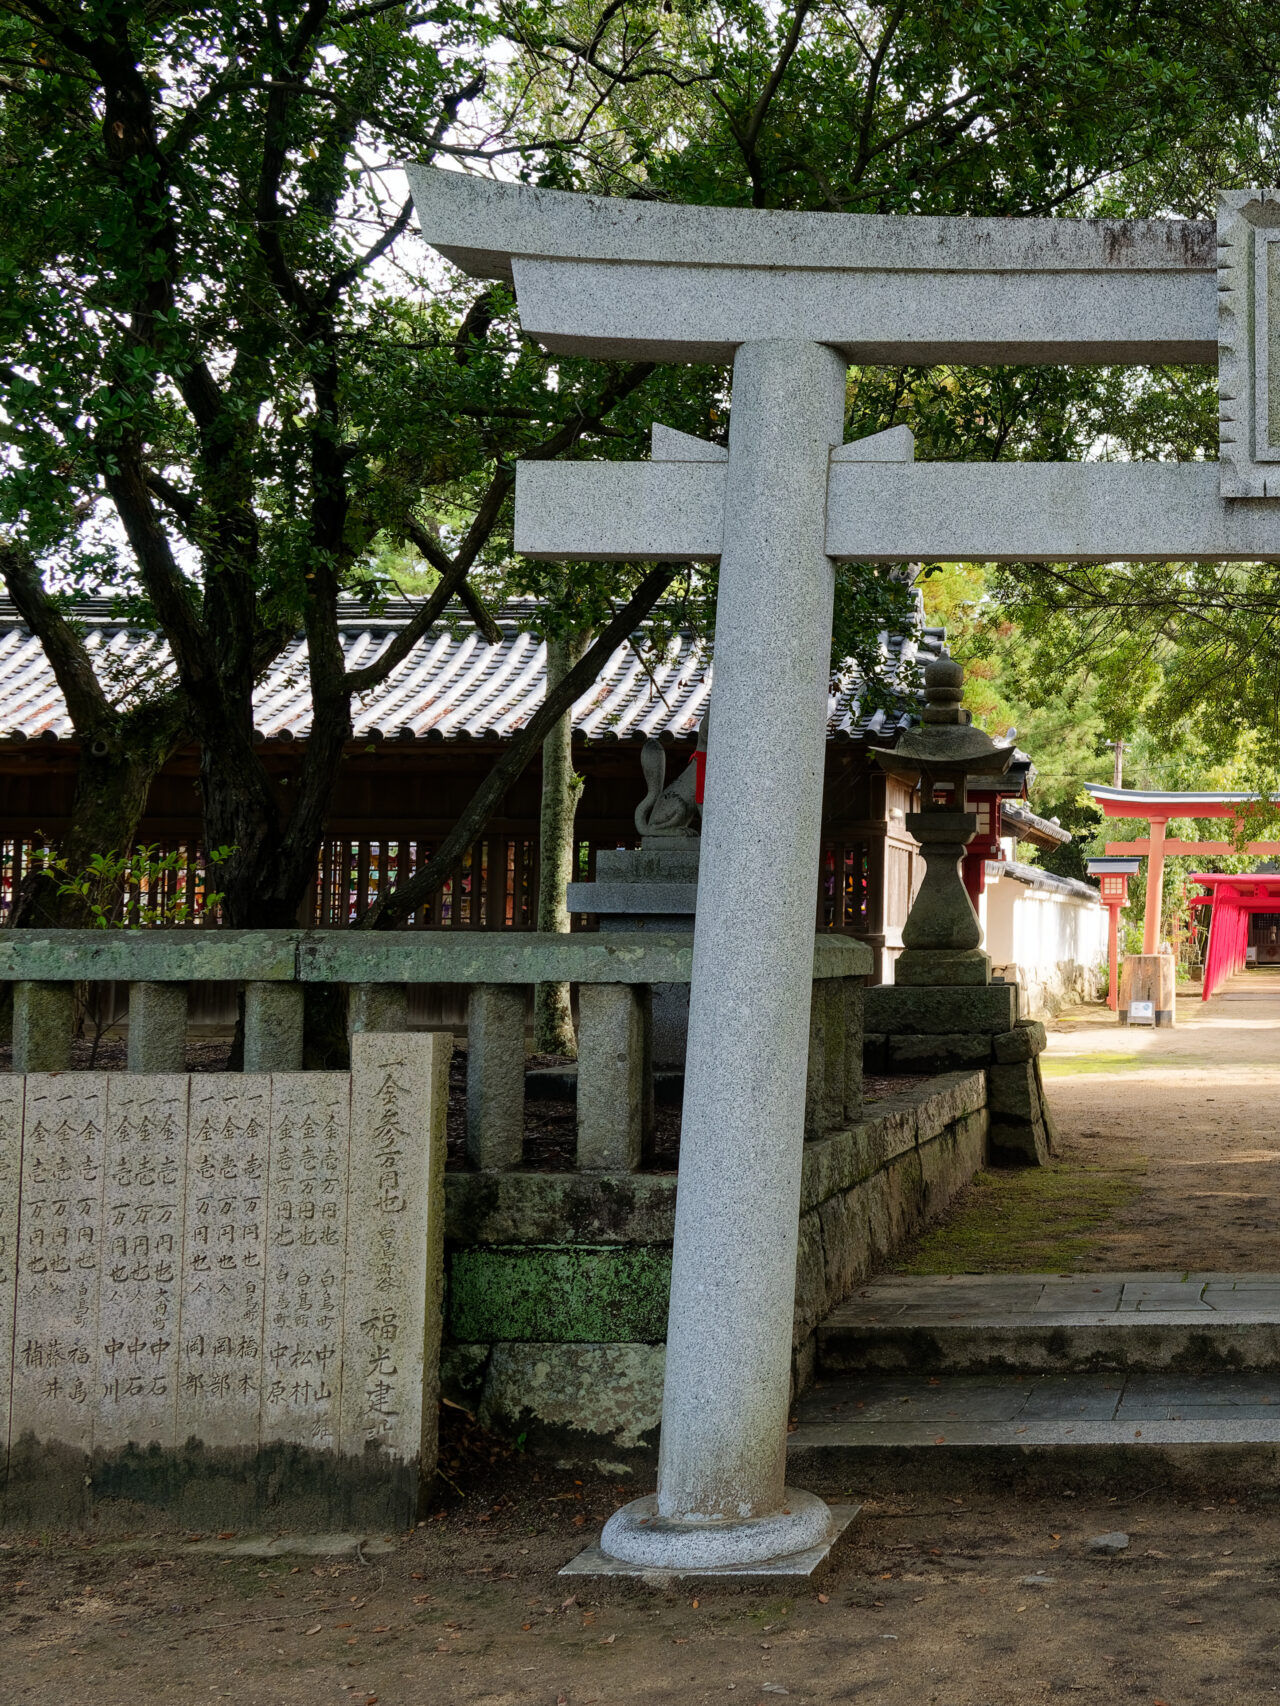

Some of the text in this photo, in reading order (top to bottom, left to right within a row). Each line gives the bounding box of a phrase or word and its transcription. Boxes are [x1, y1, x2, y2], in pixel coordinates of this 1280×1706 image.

[104, 1337, 124, 1403] 中川
[236, 1335, 258, 1395] 橋本
[288, 1343, 313, 1406] 松村
